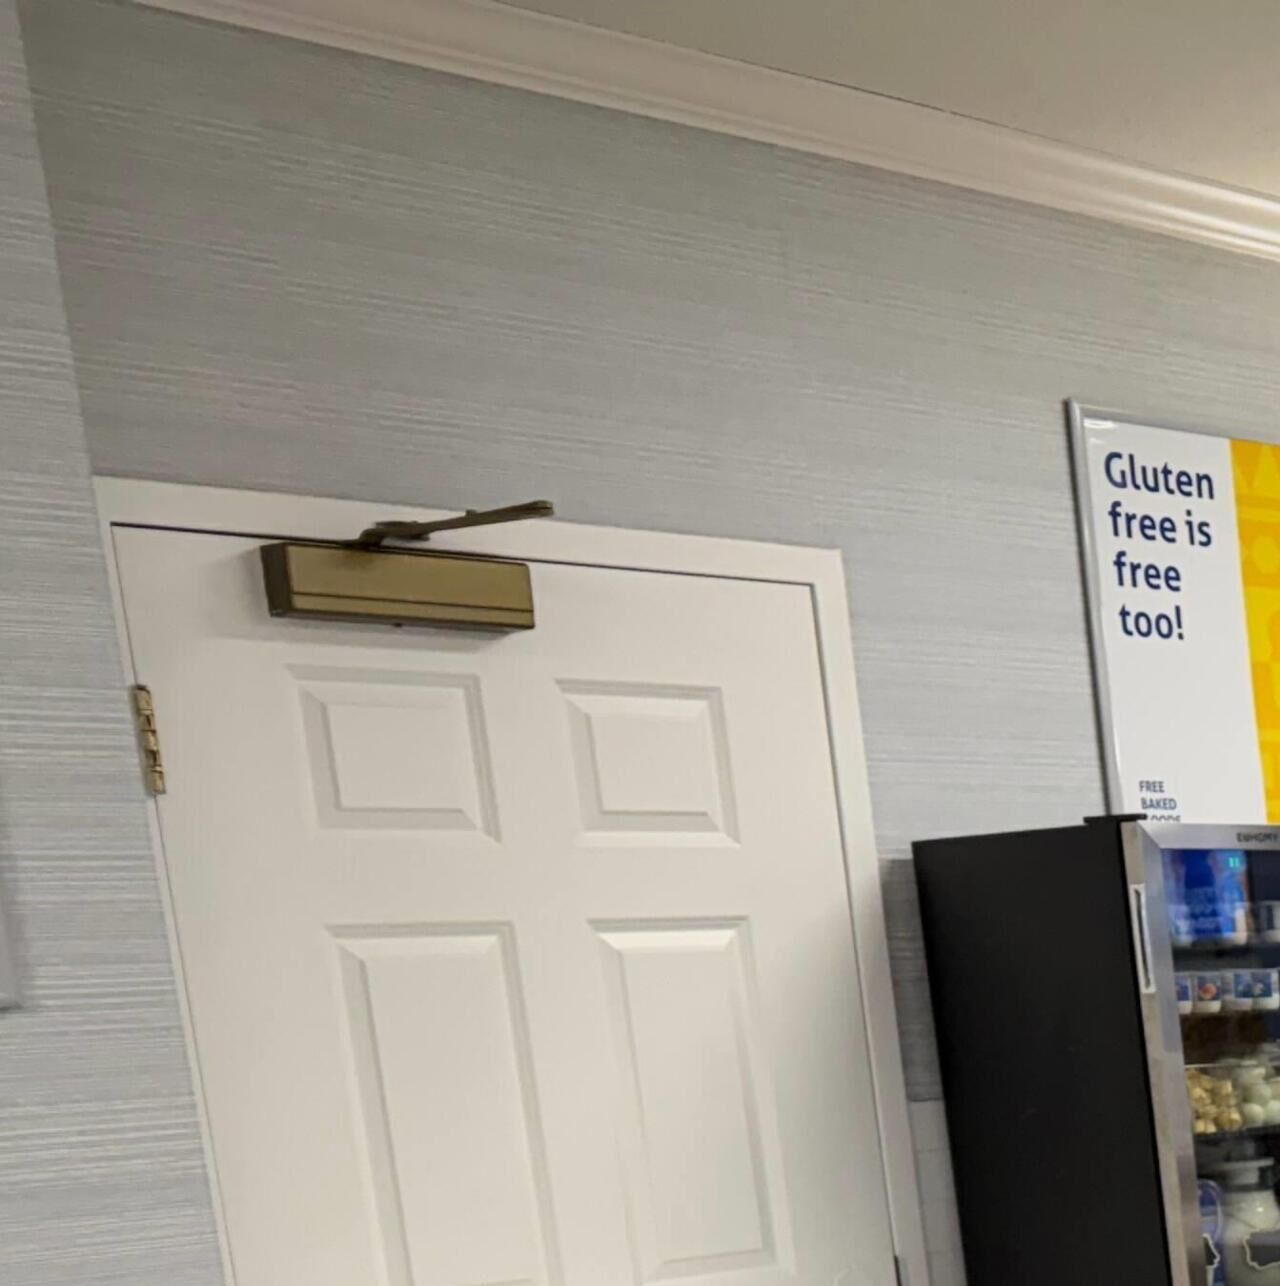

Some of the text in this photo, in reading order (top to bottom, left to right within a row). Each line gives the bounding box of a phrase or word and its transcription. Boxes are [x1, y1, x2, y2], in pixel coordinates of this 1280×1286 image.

[1104, 451, 1215, 500] Gluten
[1108, 501, 1213, 547] free is
[1113, 550, 1182, 592] free
[1119, 603, 1186, 641] too!
[1138, 780, 1165, 794] FREE
[1140, 797, 1178, 811] BAKED
